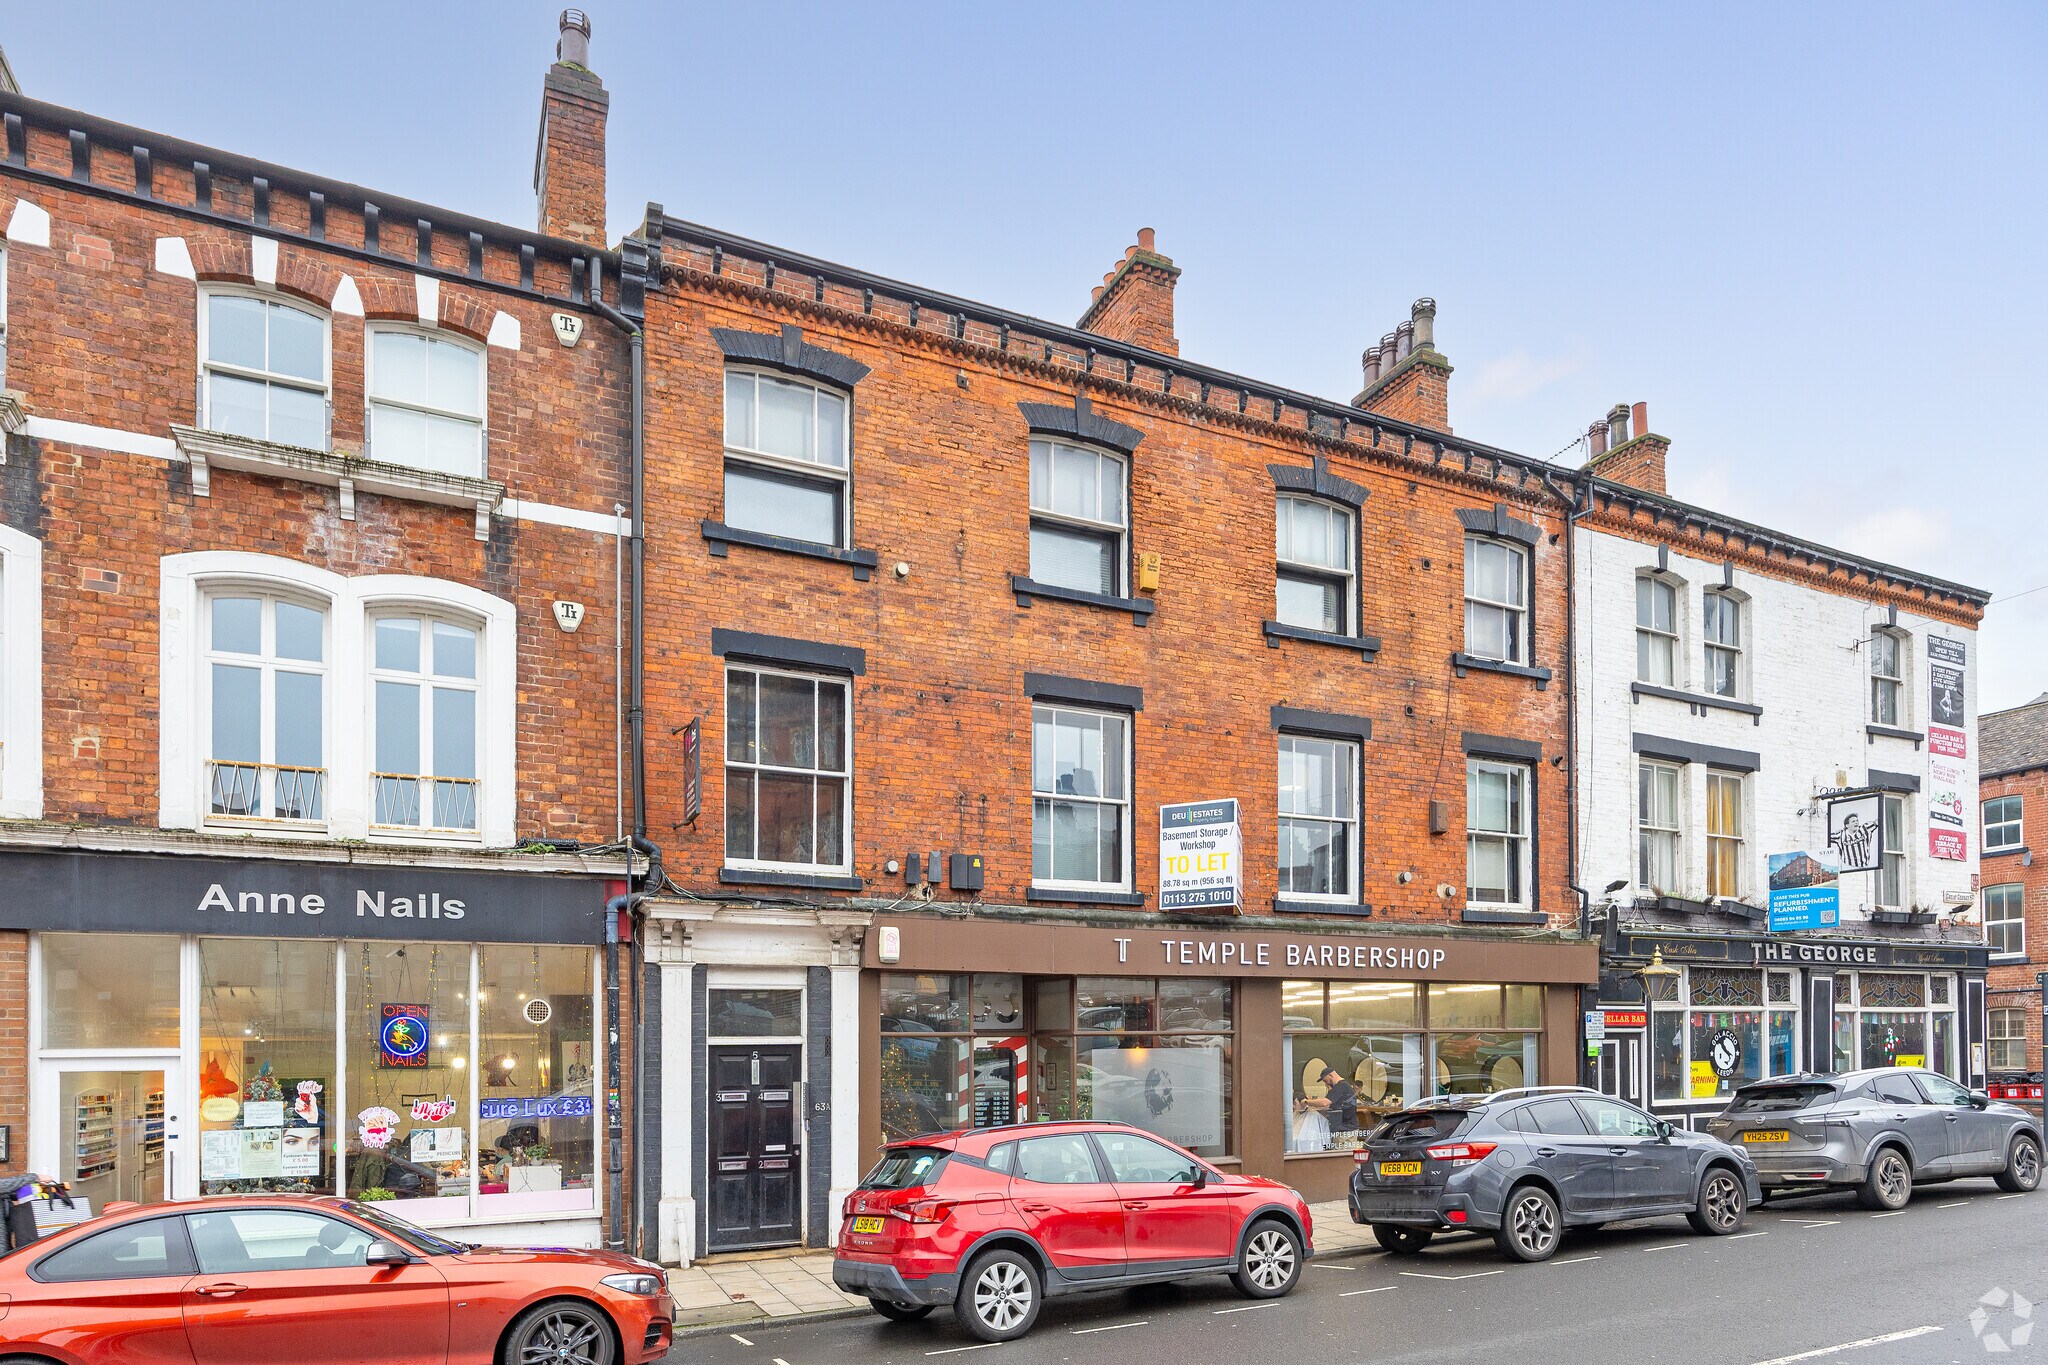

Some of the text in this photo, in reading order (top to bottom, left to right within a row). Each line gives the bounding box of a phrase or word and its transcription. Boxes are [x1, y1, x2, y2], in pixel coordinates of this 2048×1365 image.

[1929, 636, 1964, 651] THE GEORGE
[1930, 738, 1952, 746] FUNCTION
[1193, 809, 1223, 818] ESTATES
[1163, 830, 1198, 840] Basement
[1200, 828, 1228, 838] Storage
[1180, 840, 1216, 850] Workshop
[1166, 852, 1230, 874] TO LET
[197, 884, 466, 920] Anne Nails
[1164, 890, 1231, 904] 0113 275 1010
[1774, 897, 1835, 908] REFURBISHMENT
[1663, 942, 1678, 954] Cask
[1751, 943, 1876, 962] THE GEORGE
[1161, 940, 1270, 966] TEMPLE
[1286, 944, 1446, 970] BARBERSHOP
[383, 1005, 428, 1018] OPEN
[1632, 1014, 1646, 1022] BAR
[382, 1052, 427, 1067] NAILS
[752, 1051, 758, 1060] 5
[1716, 1068, 1734, 1076] LEEDS
[1691, 1076, 1716, 1084] ARNING
[716, 1094, 722, 1102] 3
[522, 1100, 556, 1118] Lux
[815, 1102, 831, 1111] 63A
[1319, 1129, 1373, 1139] @TEMPLEBARBER
[1746, 1132, 1768, 1140] YH25
[758, 1160, 764, 1168] 2
[1384, 1163, 1418, 1173] VE68 YCN
